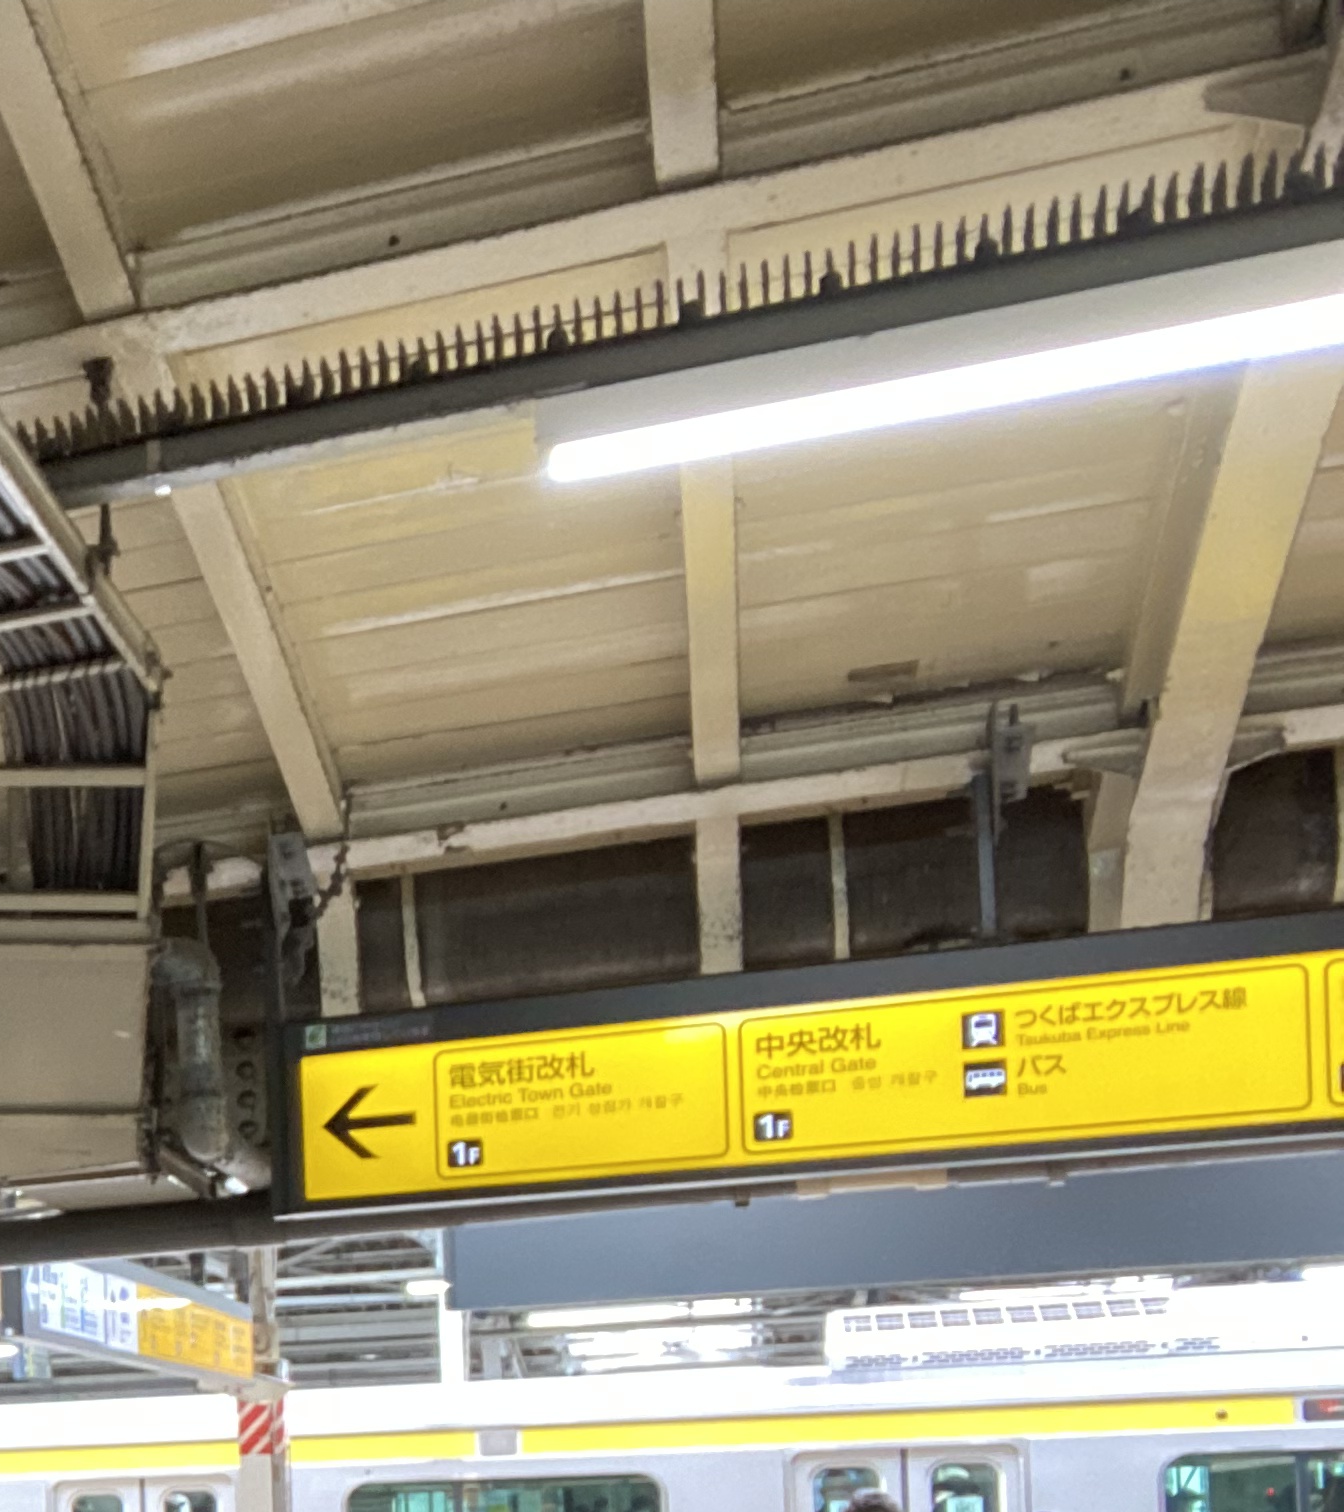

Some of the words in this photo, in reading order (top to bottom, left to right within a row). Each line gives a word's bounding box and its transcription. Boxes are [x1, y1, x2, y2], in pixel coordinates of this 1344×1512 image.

[1014, 986, 1248, 1029] つくばエクスプレス線
[755, 1022, 882, 1060] 中央改札
[1016, 1029, 1082, 1047] Tsukuba
[1086, 1022, 1151, 1042] Express
[1155, 1019, 1191, 1035] Line
[449, 1050, 596, 1090] 電気街改札
[756, 1059, 825, 1081] Central
[830, 1056, 877, 1074] Gate
[1016, 1054, 1068, 1078] バス
[449, 1090, 513, 1111] Electric
[518, 1086, 564, 1104] Town
[569, 1081, 613, 1100] Gate
[1017, 1082, 1048, 1098] Bus
[758, 1113, 790, 1140] 1F
[451, 1140, 481, 1167] 1F
